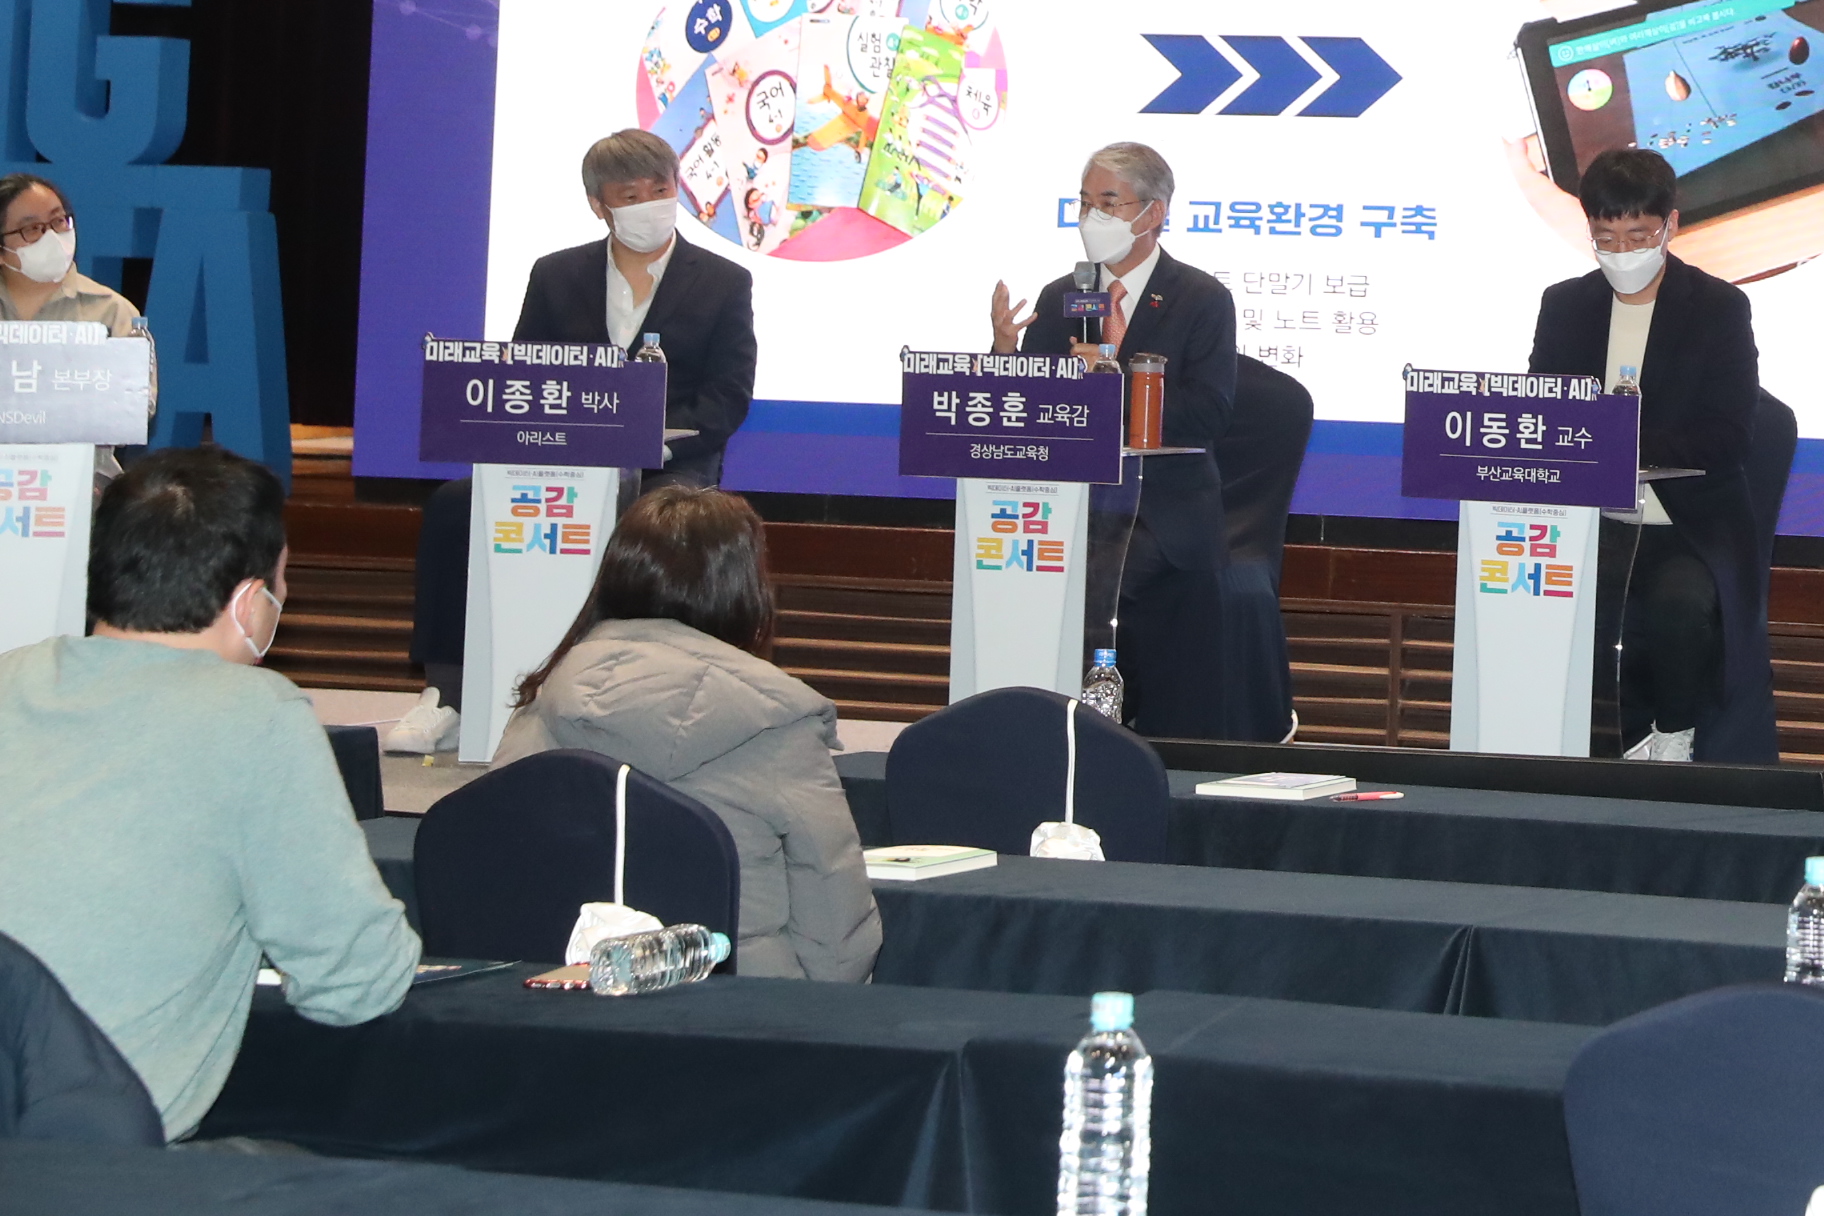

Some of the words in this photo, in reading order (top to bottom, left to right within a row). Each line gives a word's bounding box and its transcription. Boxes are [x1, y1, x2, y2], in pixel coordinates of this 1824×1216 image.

[857, 32, 882, 53] 실험
[756, 81, 784, 110] 국어
[965, 85, 992, 116] 체육
[1187, 200, 1344, 237] 교육환경
[1360, 204, 1438, 240] 구축
[1243, 271, 1312, 295] 단말기
[1323, 274, 1370, 298] 보급
[1243, 309, 1263, 331] 및
[1274, 310, 1322, 330] 노트
[1331, 310, 1379, 336] 활용
[425, 341, 500, 364] 미래교육
[904, 353, 971, 375] 미래교육
[1259, 344, 1304, 368] 변화
[11, 359, 42, 393] 남
[52, 369, 112, 392] 본부장
[1406, 371, 1478, 395] 미래교육
[581, 391, 620, 414] 박사
[1036, 404, 1089, 427] 교육감
[517, 430, 567, 446] 아리스트
[1555, 426, 1593, 449] 교수
[969, 443, 1049, 461] 경상남도교육청
[1476, 465, 1561, 484] 부산교육대학교
[511, 485, 578, 518] 공감
[0, 506, 66, 538] 서트
[991, 500, 1052, 534] 공감
[493, 521, 591, 555] 콘서트
[1495, 521, 1561, 558] 공감
[975, 537, 1065, 573] 콘서트
[1479, 559, 1574, 598] 콘서트
